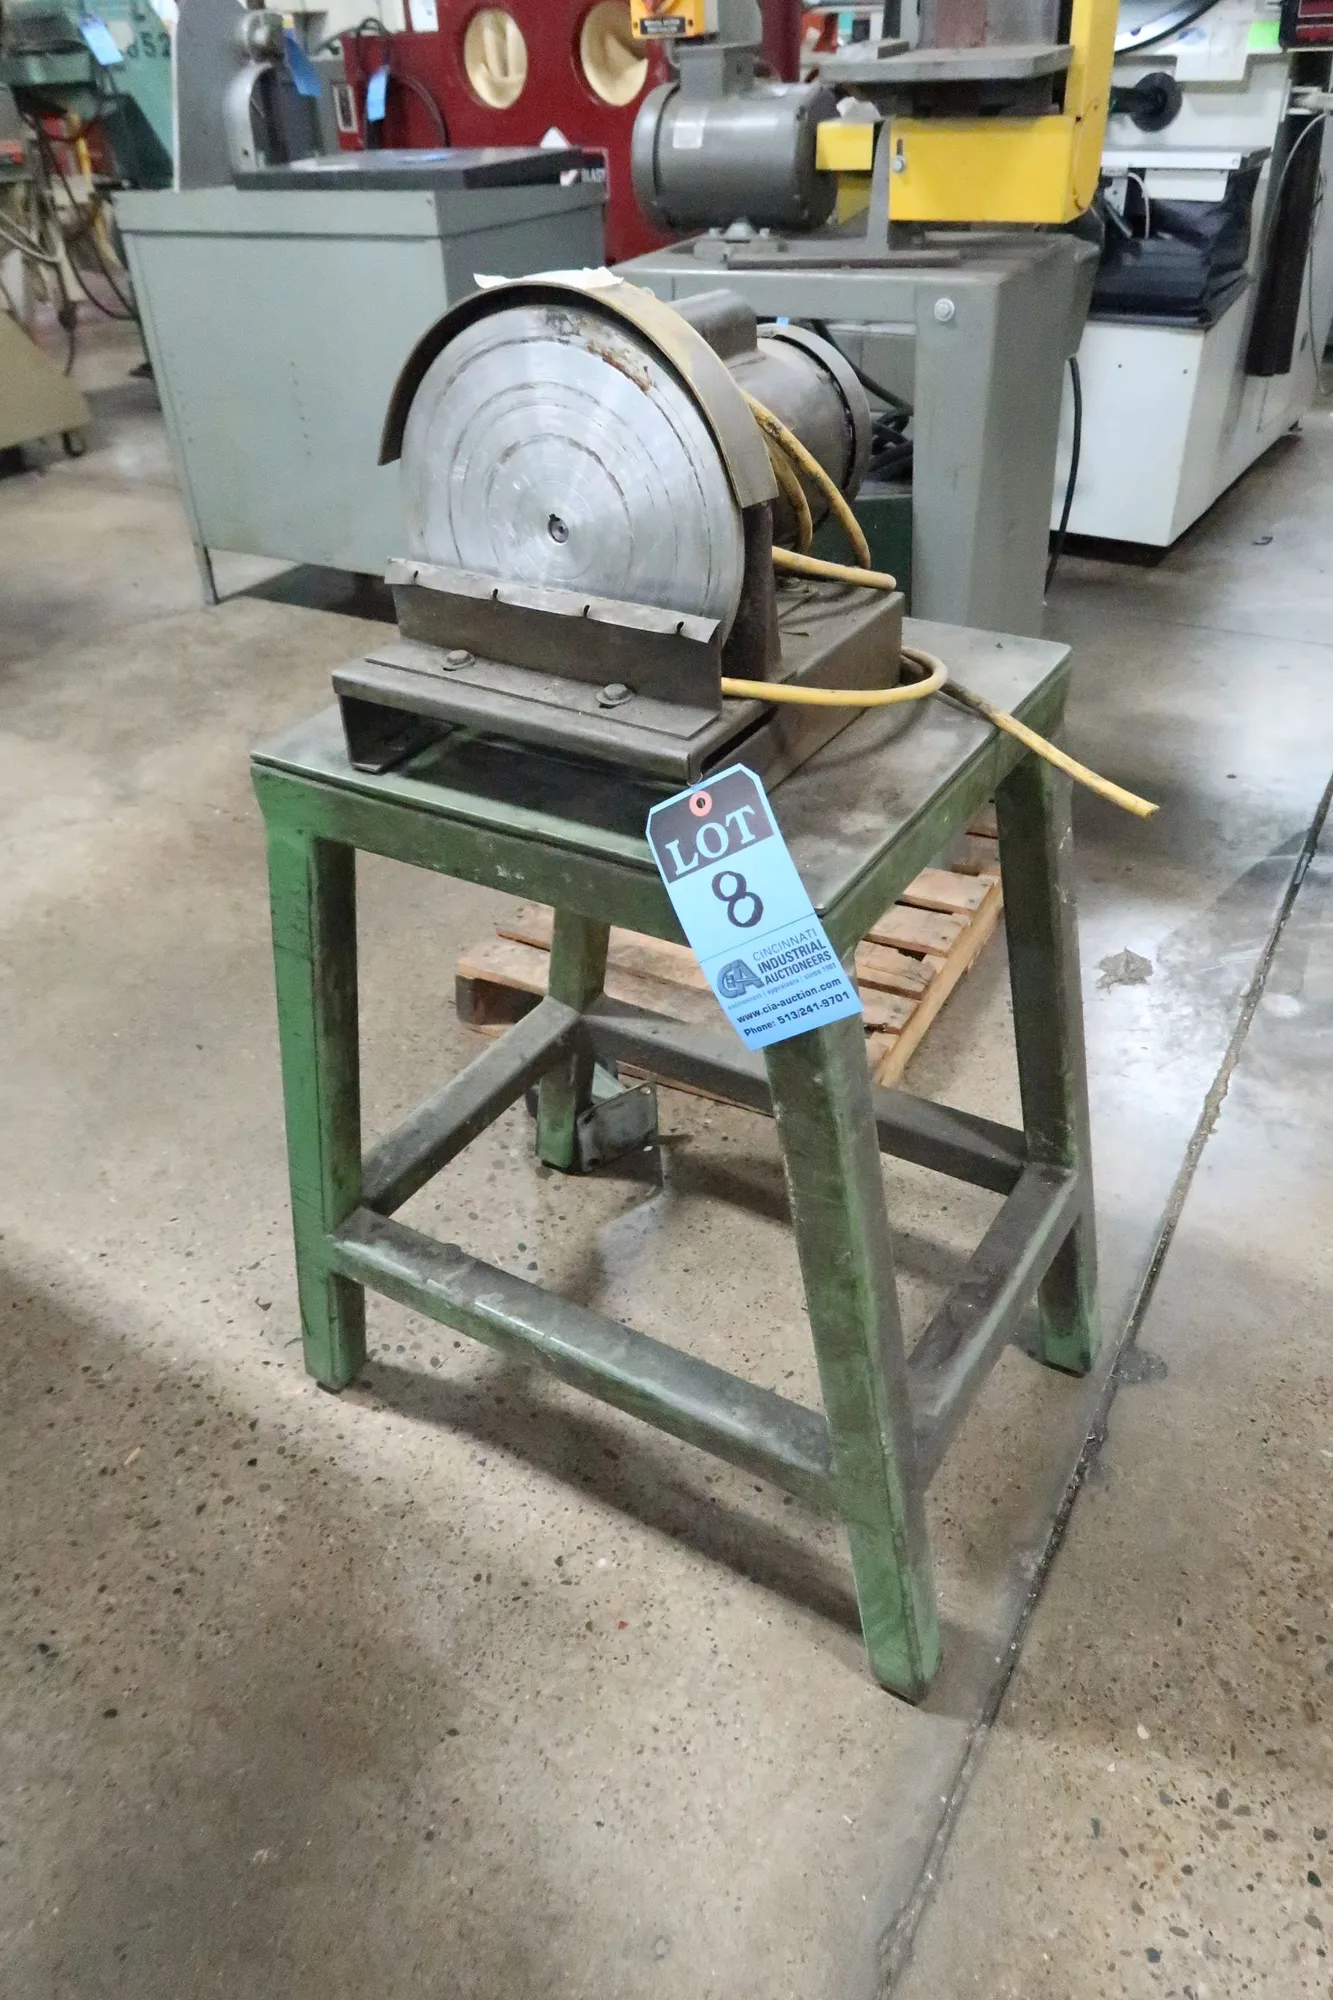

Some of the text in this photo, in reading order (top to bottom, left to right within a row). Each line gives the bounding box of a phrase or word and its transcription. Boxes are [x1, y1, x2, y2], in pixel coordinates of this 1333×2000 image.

[665, 805, 756, 876] LOT
[711, 870, 764, 928] 8
[752, 928, 818, 961] CINCINNATI
[757, 938, 827, 974] INDUSTRIAL
[764, 950, 832, 986] AUCTIONEERS
[736, 978, 842, 1024] www.cia-auction.com
[743, 991, 851, 1037] Phone: 513/241-9701
